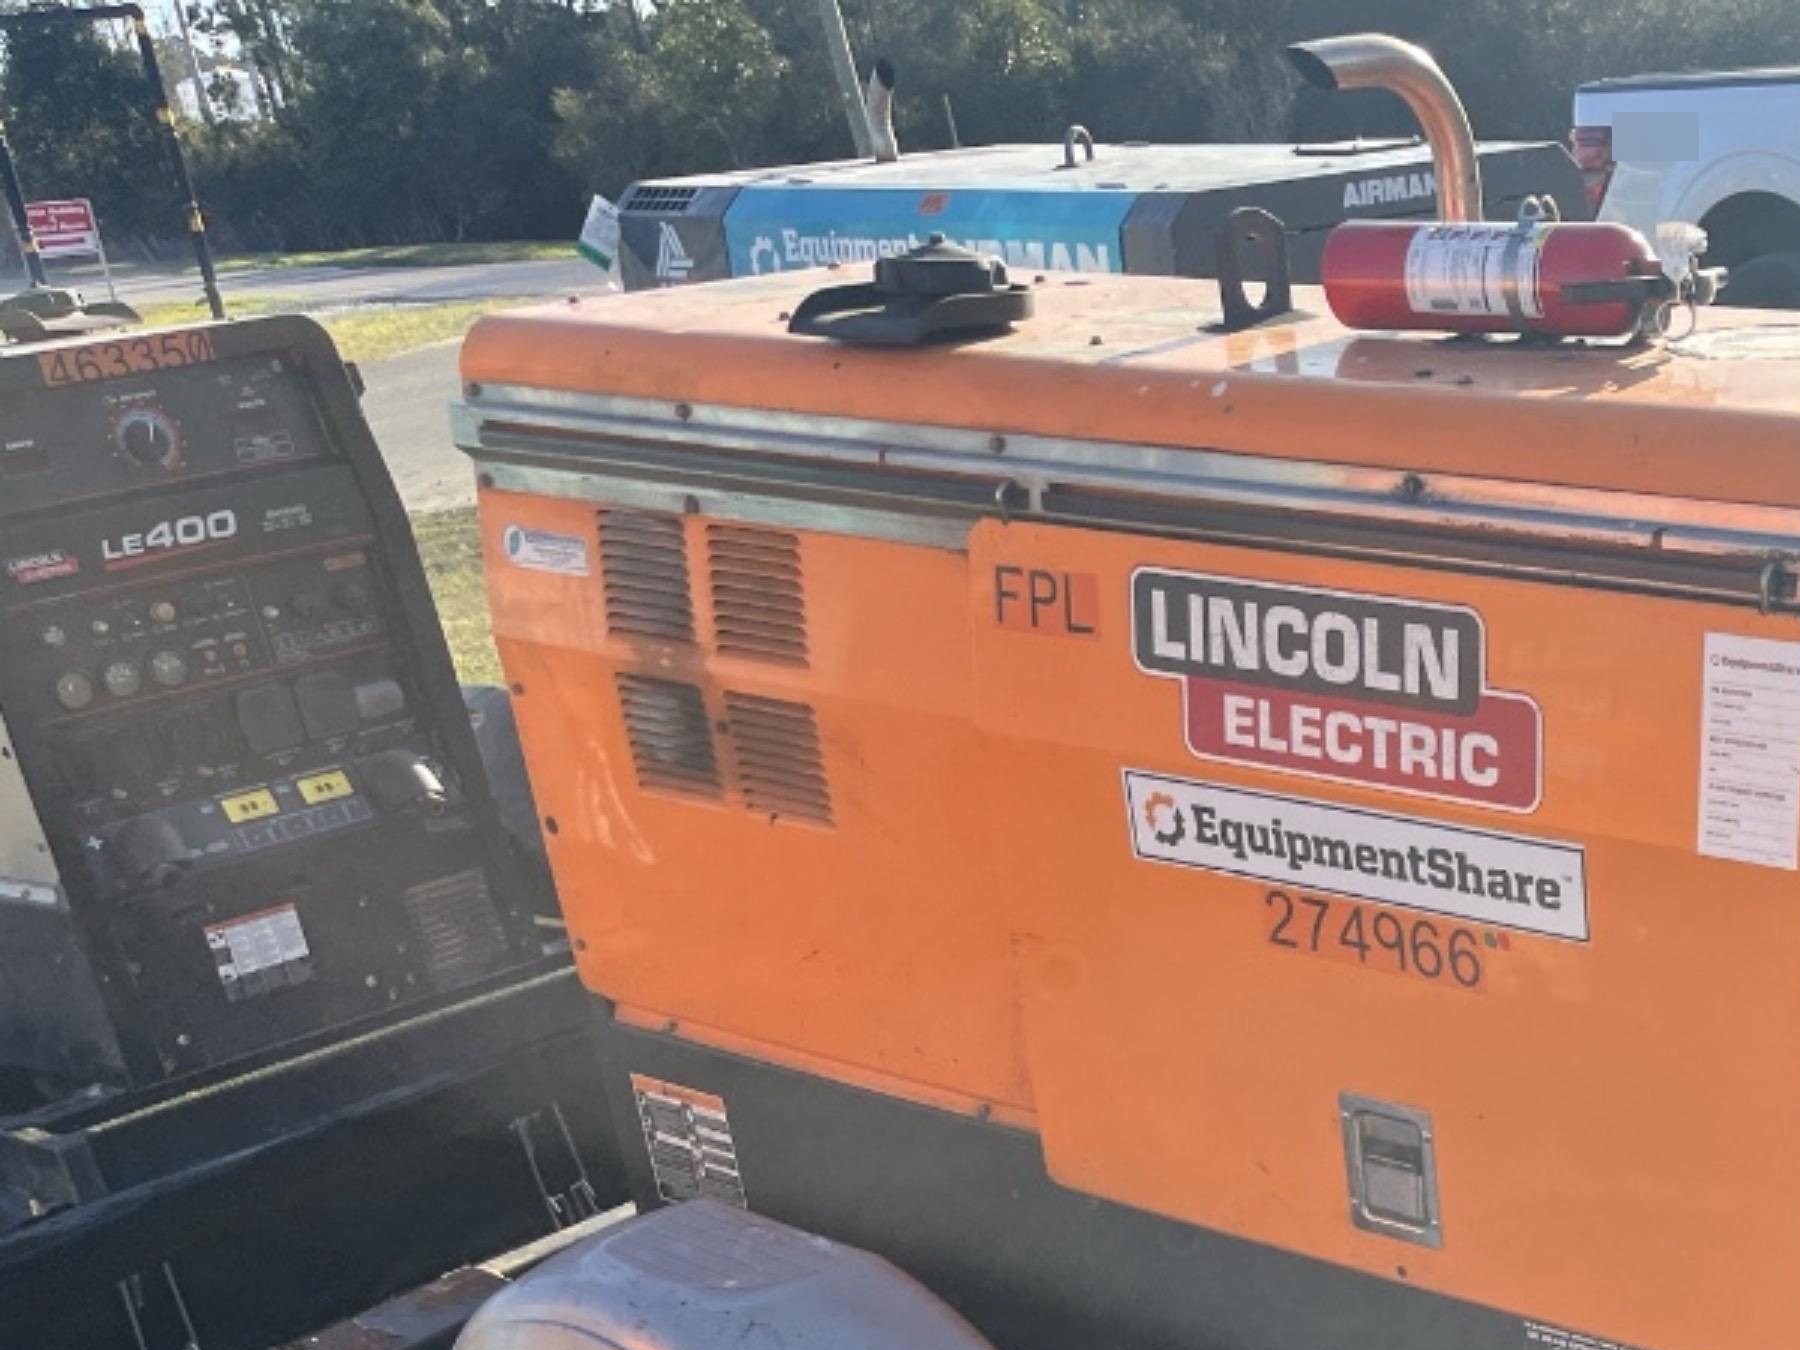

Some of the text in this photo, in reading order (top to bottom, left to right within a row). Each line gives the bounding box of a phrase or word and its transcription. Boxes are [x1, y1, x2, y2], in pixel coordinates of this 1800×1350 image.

[102, 509, 238, 560] LE400
[993, 563, 1095, 636] FPL
[1149, 588, 1462, 701] LINCOLN
[1222, 694, 1500, 788] ELECTRIC
[1191, 804, 1563, 911] EquipmentShare
[1264, 890, 1482, 989] 274966
